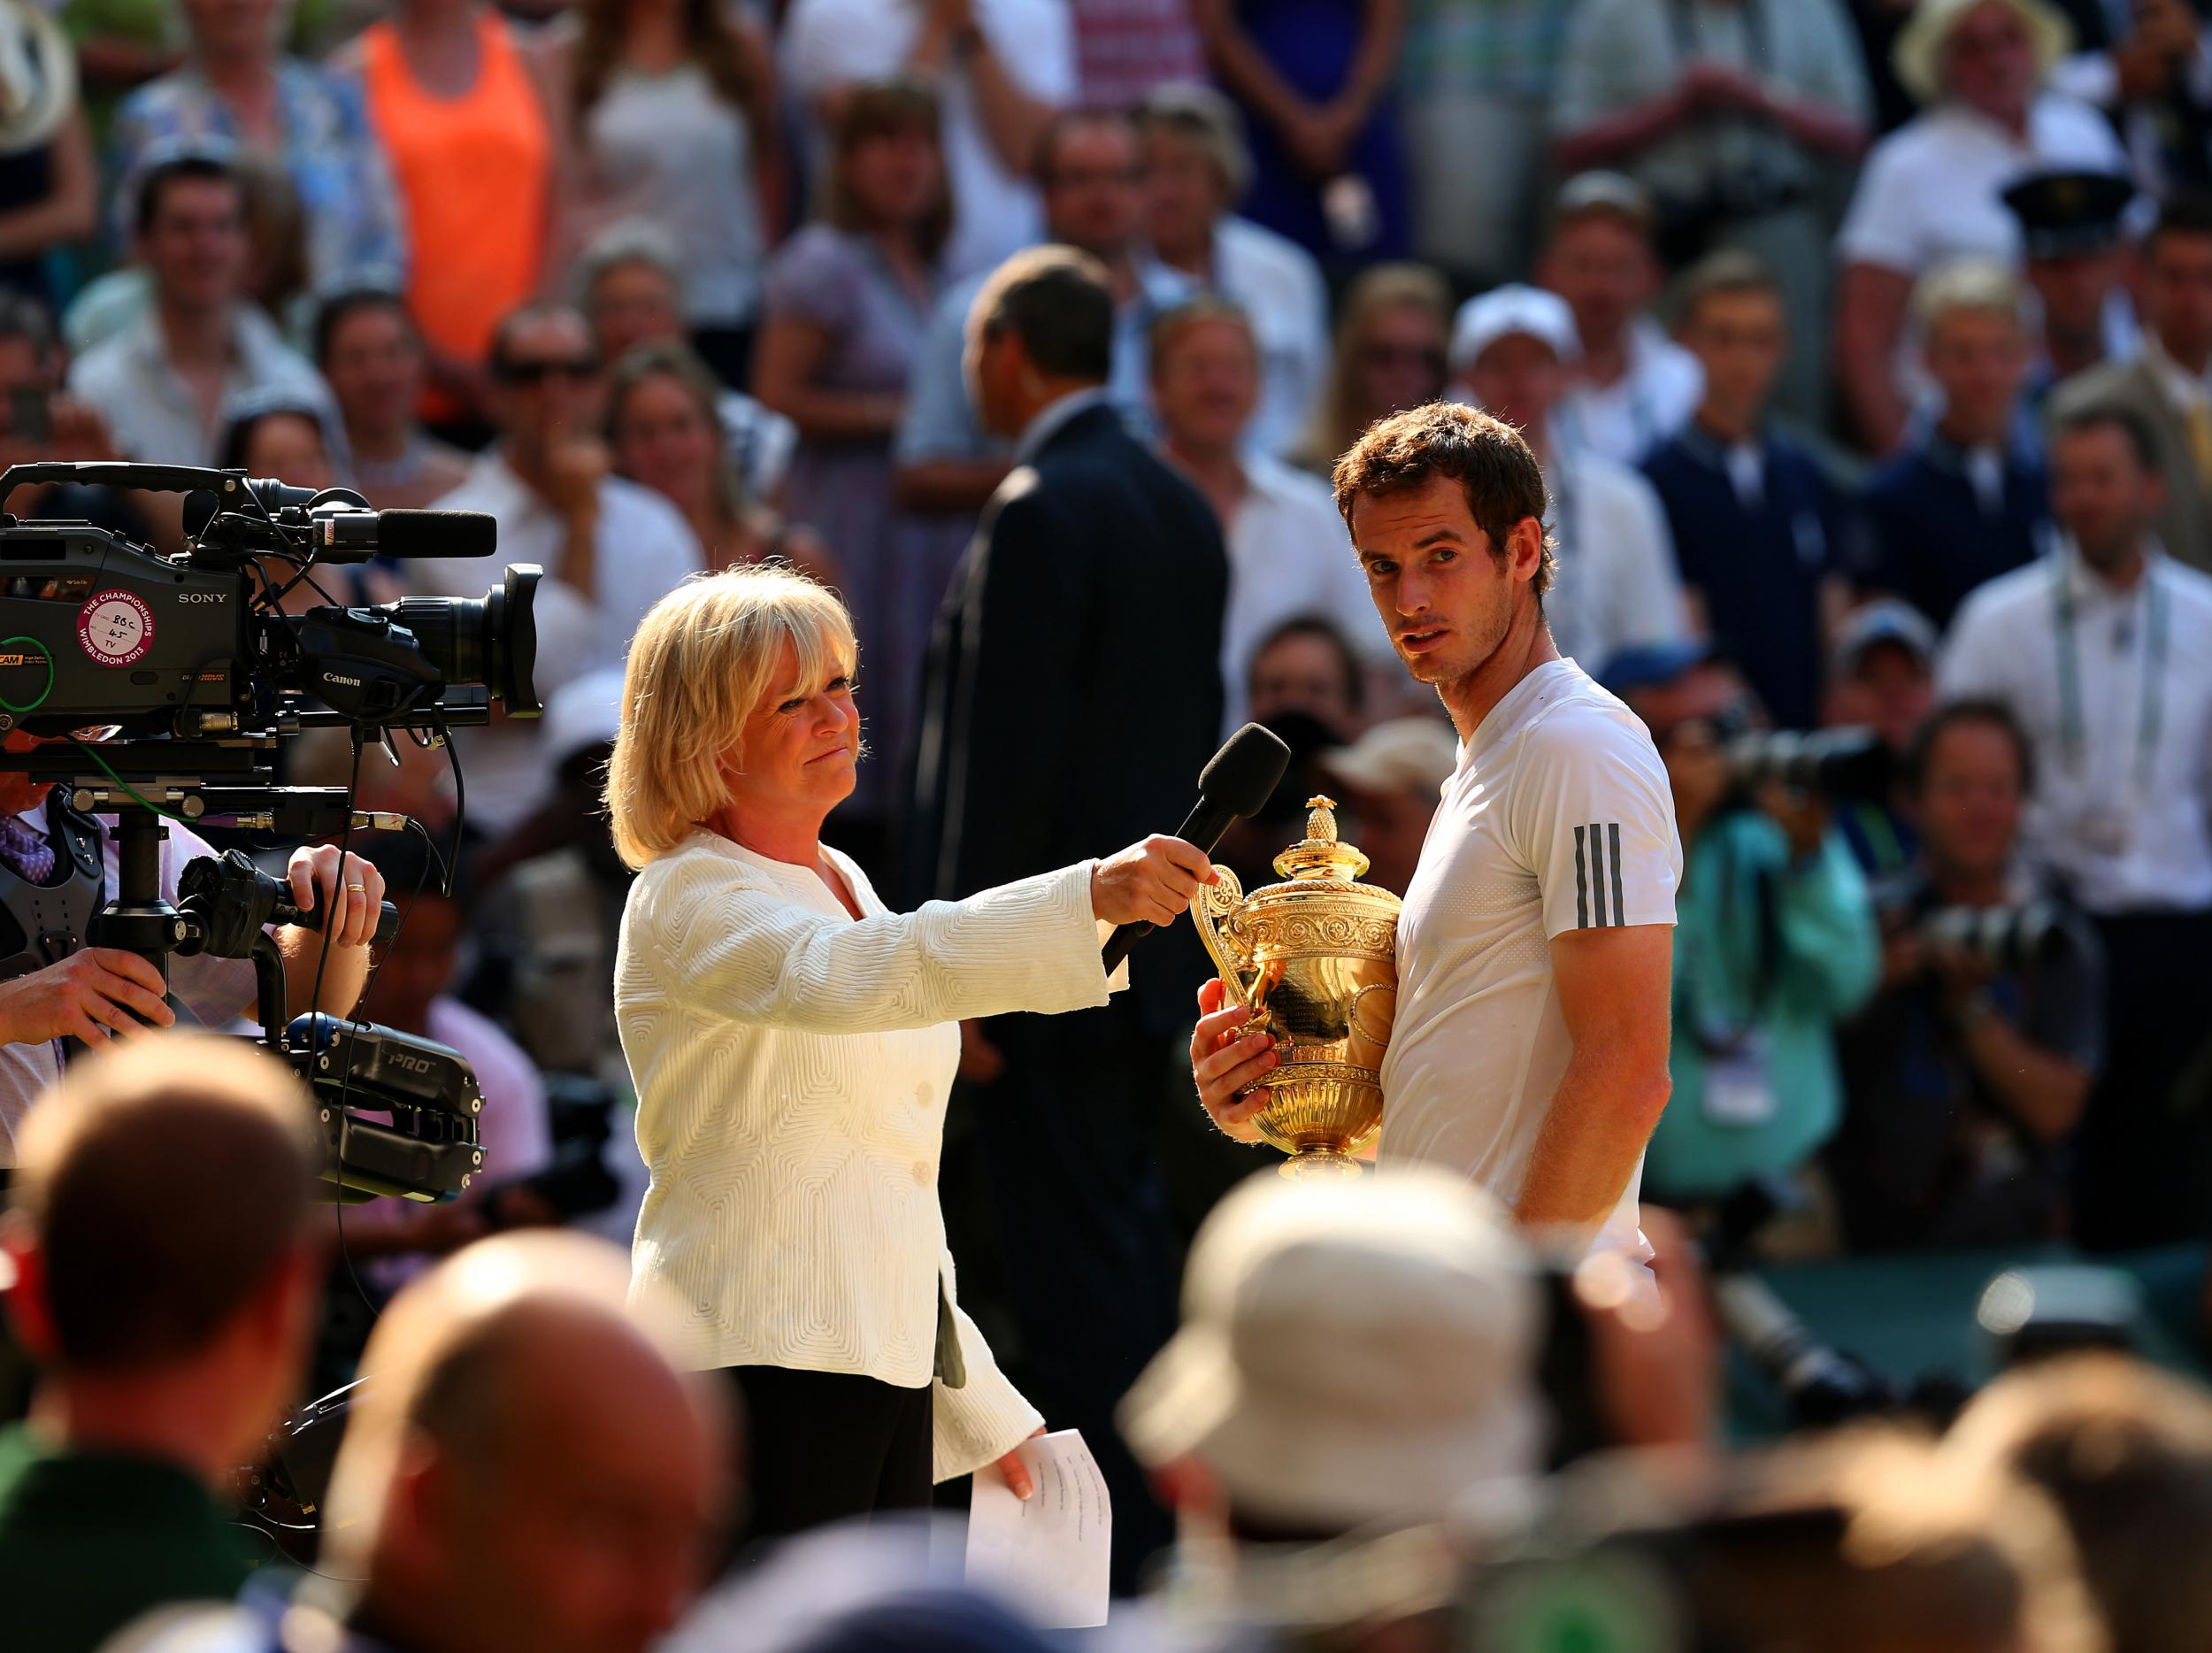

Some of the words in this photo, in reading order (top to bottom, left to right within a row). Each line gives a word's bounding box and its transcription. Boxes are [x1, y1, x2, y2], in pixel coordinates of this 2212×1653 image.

[179, 594, 227, 603] SONY
[83, 599, 99, 615] THE
[99, 592, 152, 637] CHAMPIONSHIPS
[112, 615, 134, 629] BBC
[109, 628, 127, 638] 45
[80, 627, 123, 665] WIMBLEDON
[125, 646, 143, 663] 2013
[323, 673, 361, 687] Canon
[388, 1053, 430, 1073] PRO
